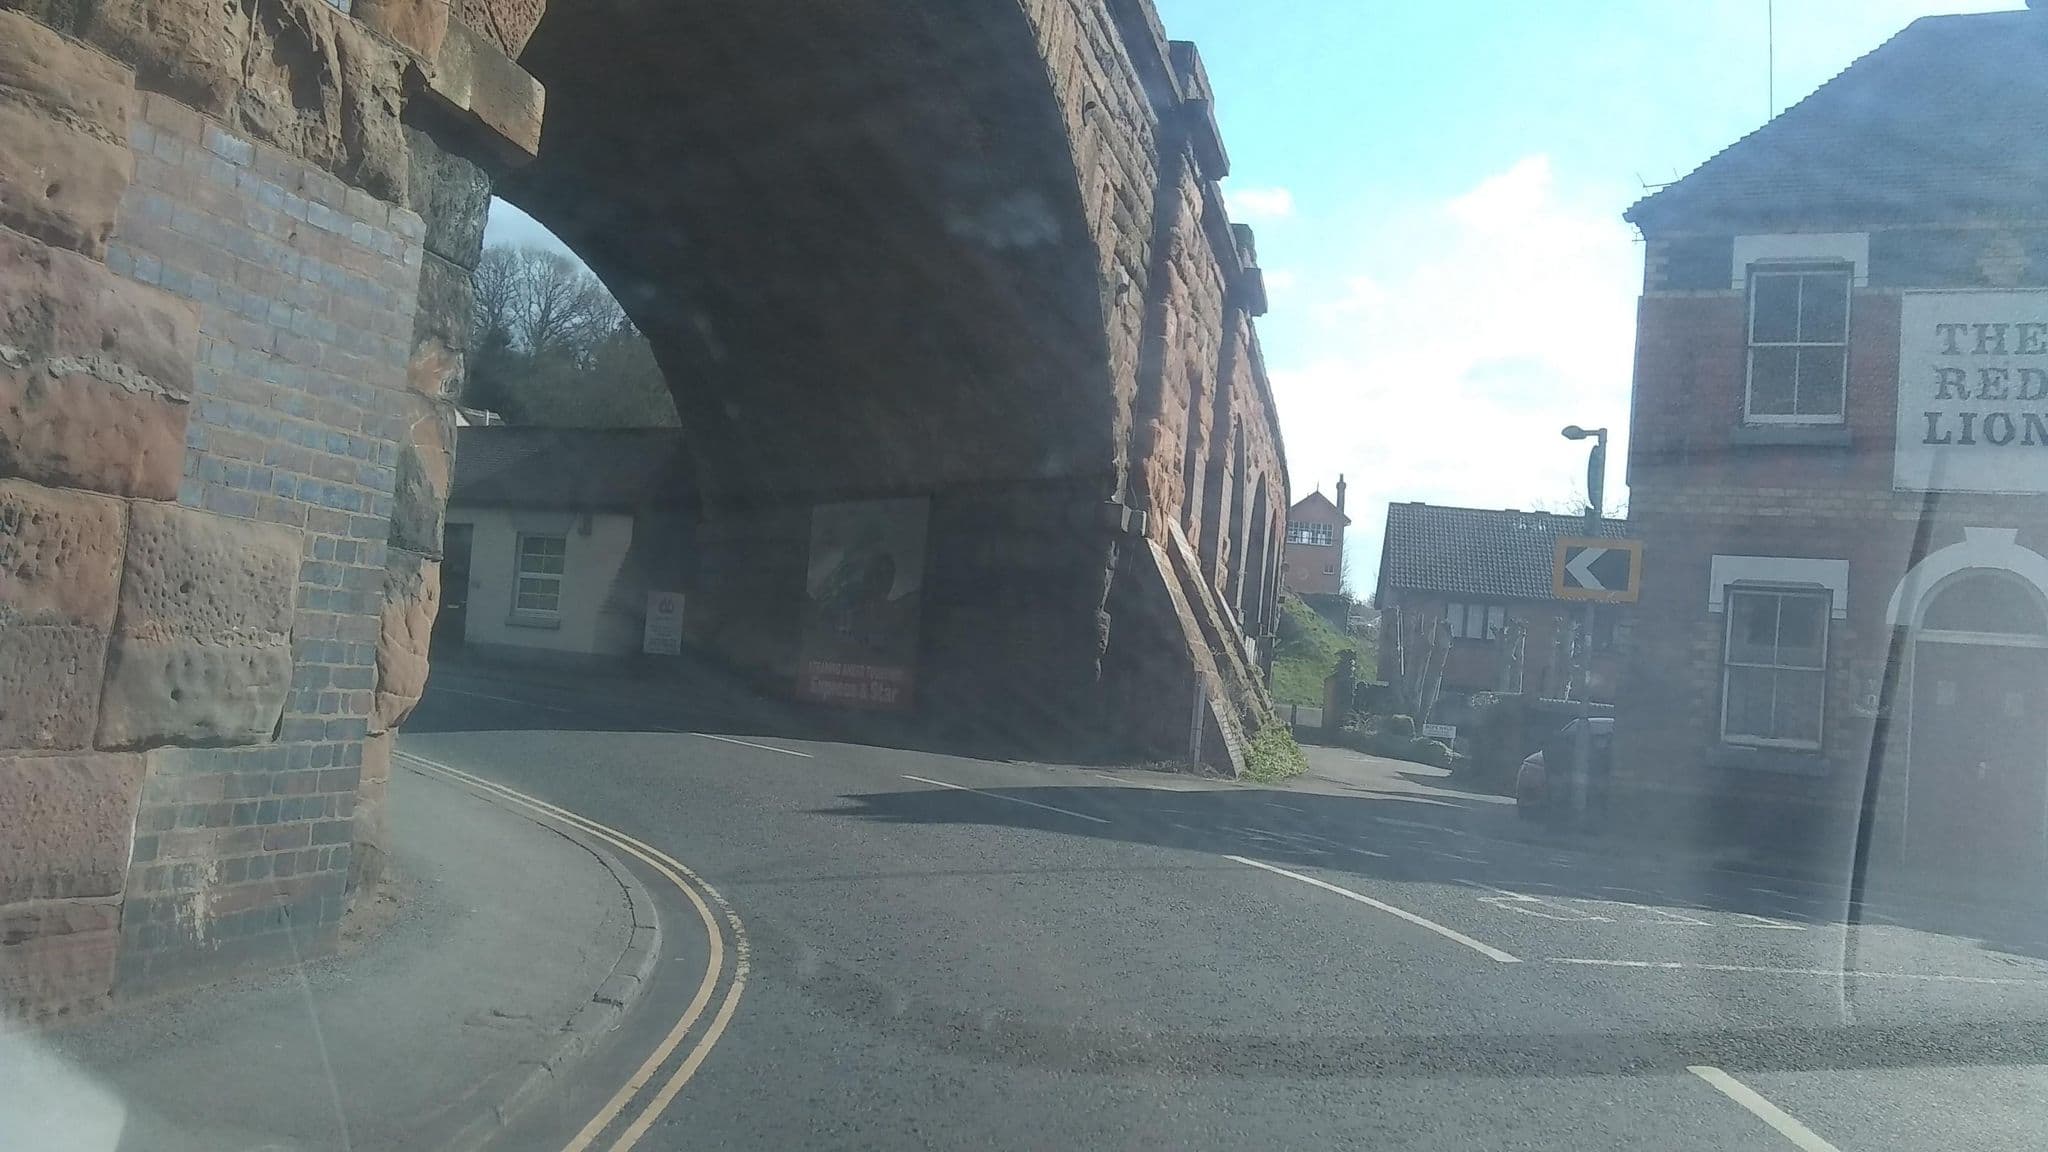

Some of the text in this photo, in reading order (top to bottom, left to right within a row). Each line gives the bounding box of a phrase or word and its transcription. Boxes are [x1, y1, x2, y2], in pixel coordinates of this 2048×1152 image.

[1935, 323, 2048, 355] THE
[1935, 367, 2048, 400] RED
[1923, 412, 2048, 446] LION
